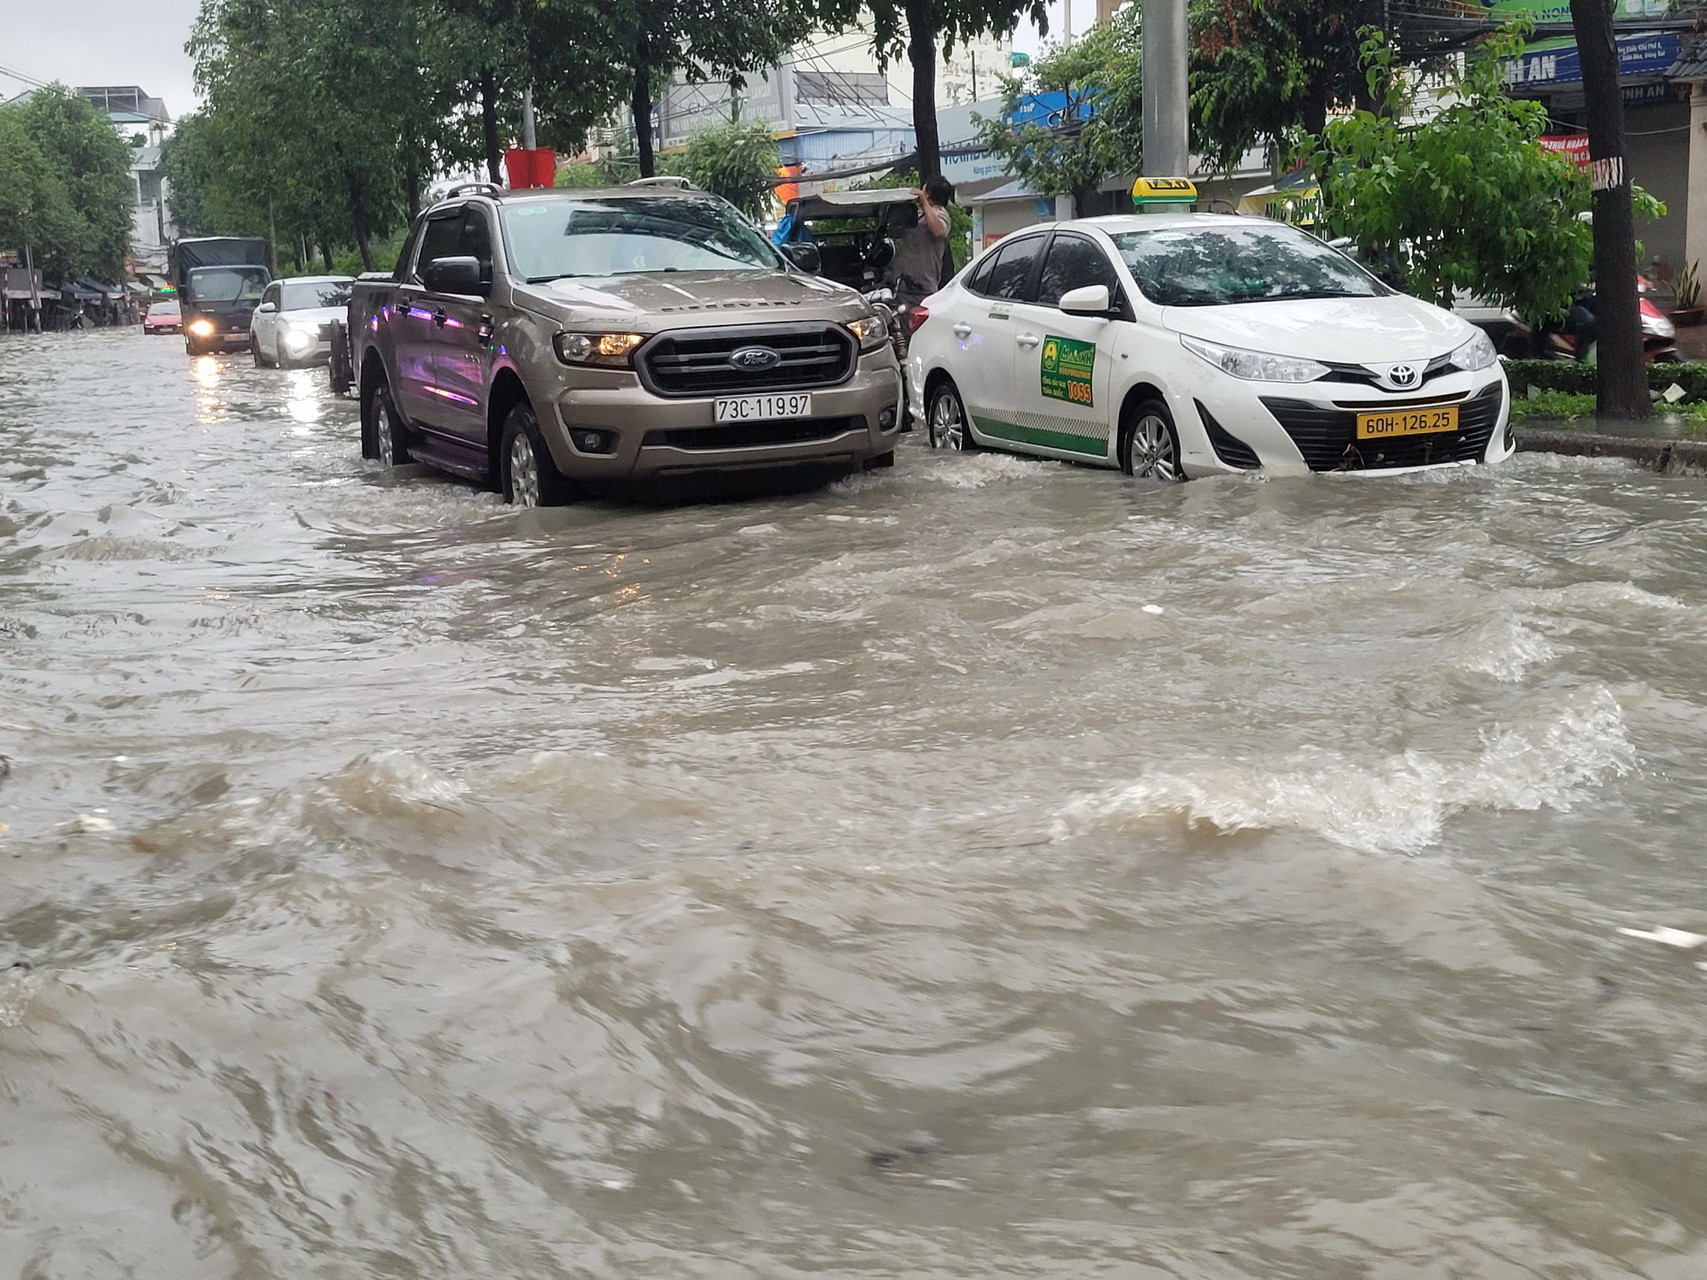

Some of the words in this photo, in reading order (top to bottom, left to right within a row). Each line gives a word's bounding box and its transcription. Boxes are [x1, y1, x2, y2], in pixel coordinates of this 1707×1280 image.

[1528, 55, 1556, 82] AN
[1646, 85, 1665, 98] AN
[743, 351, 769, 366] Ford
[1067, 380, 1091, 403] 1055
[717, 395, 810, 421] 73C-119.97
[1366, 412, 1450, 434] 60H-126.25
